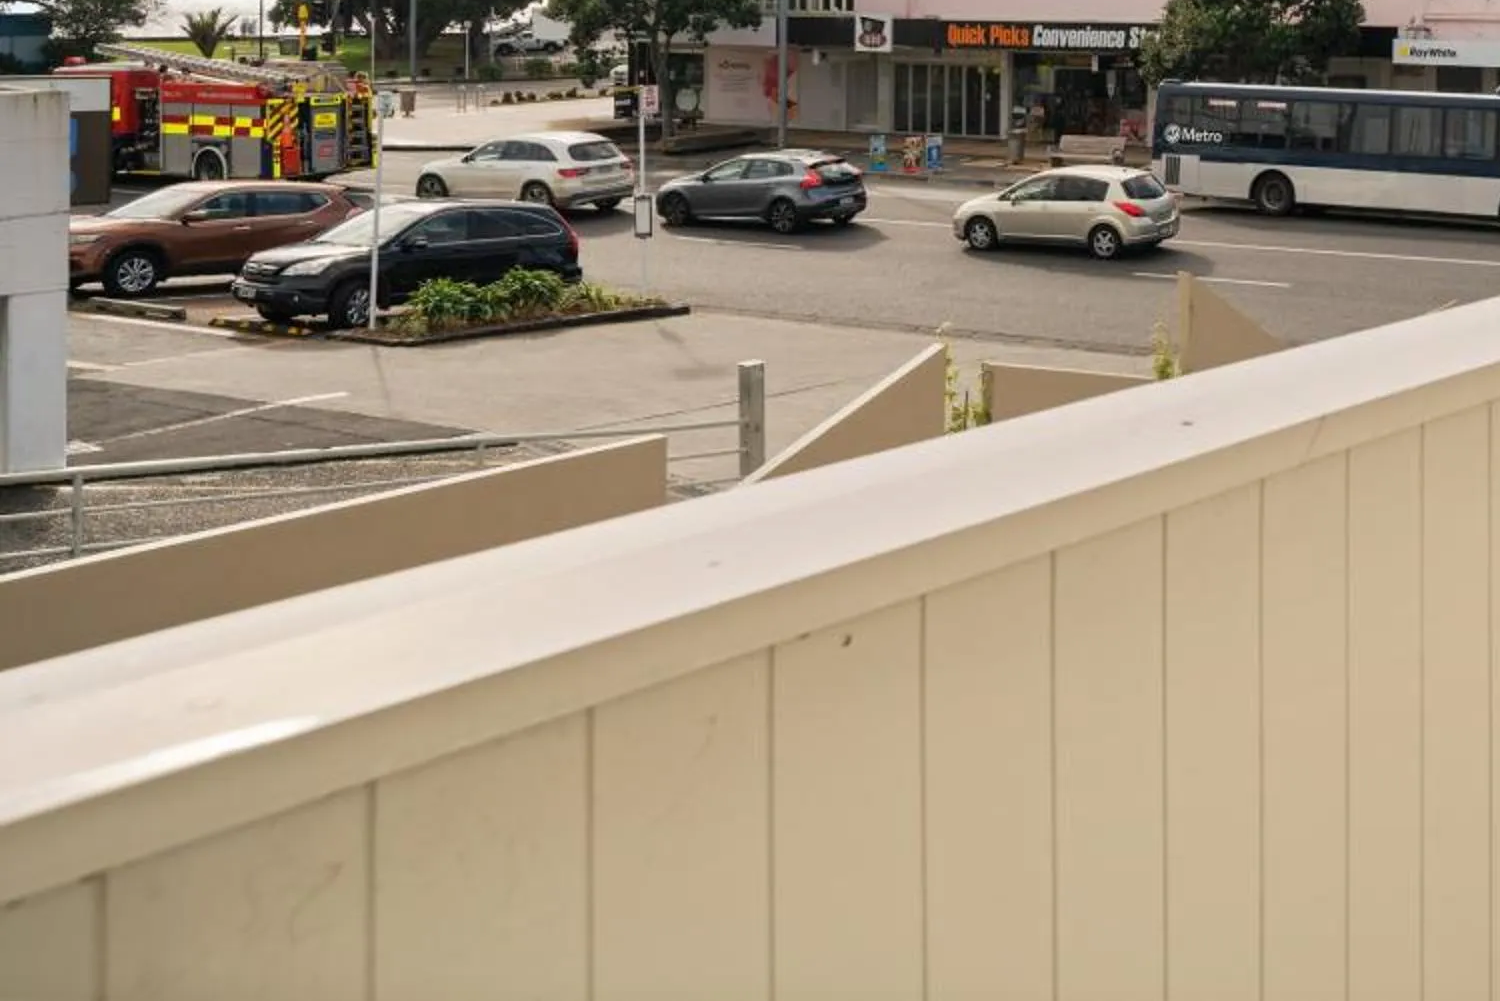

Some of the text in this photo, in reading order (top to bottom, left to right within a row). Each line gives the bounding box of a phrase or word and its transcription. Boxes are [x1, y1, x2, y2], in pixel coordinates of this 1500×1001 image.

[948, 24, 985, 46] Quick
[990, 26, 1028, 46] Picks
[1032, 25, 1125, 48] Convenience
[1182, 127, 1223, 142] Metro
